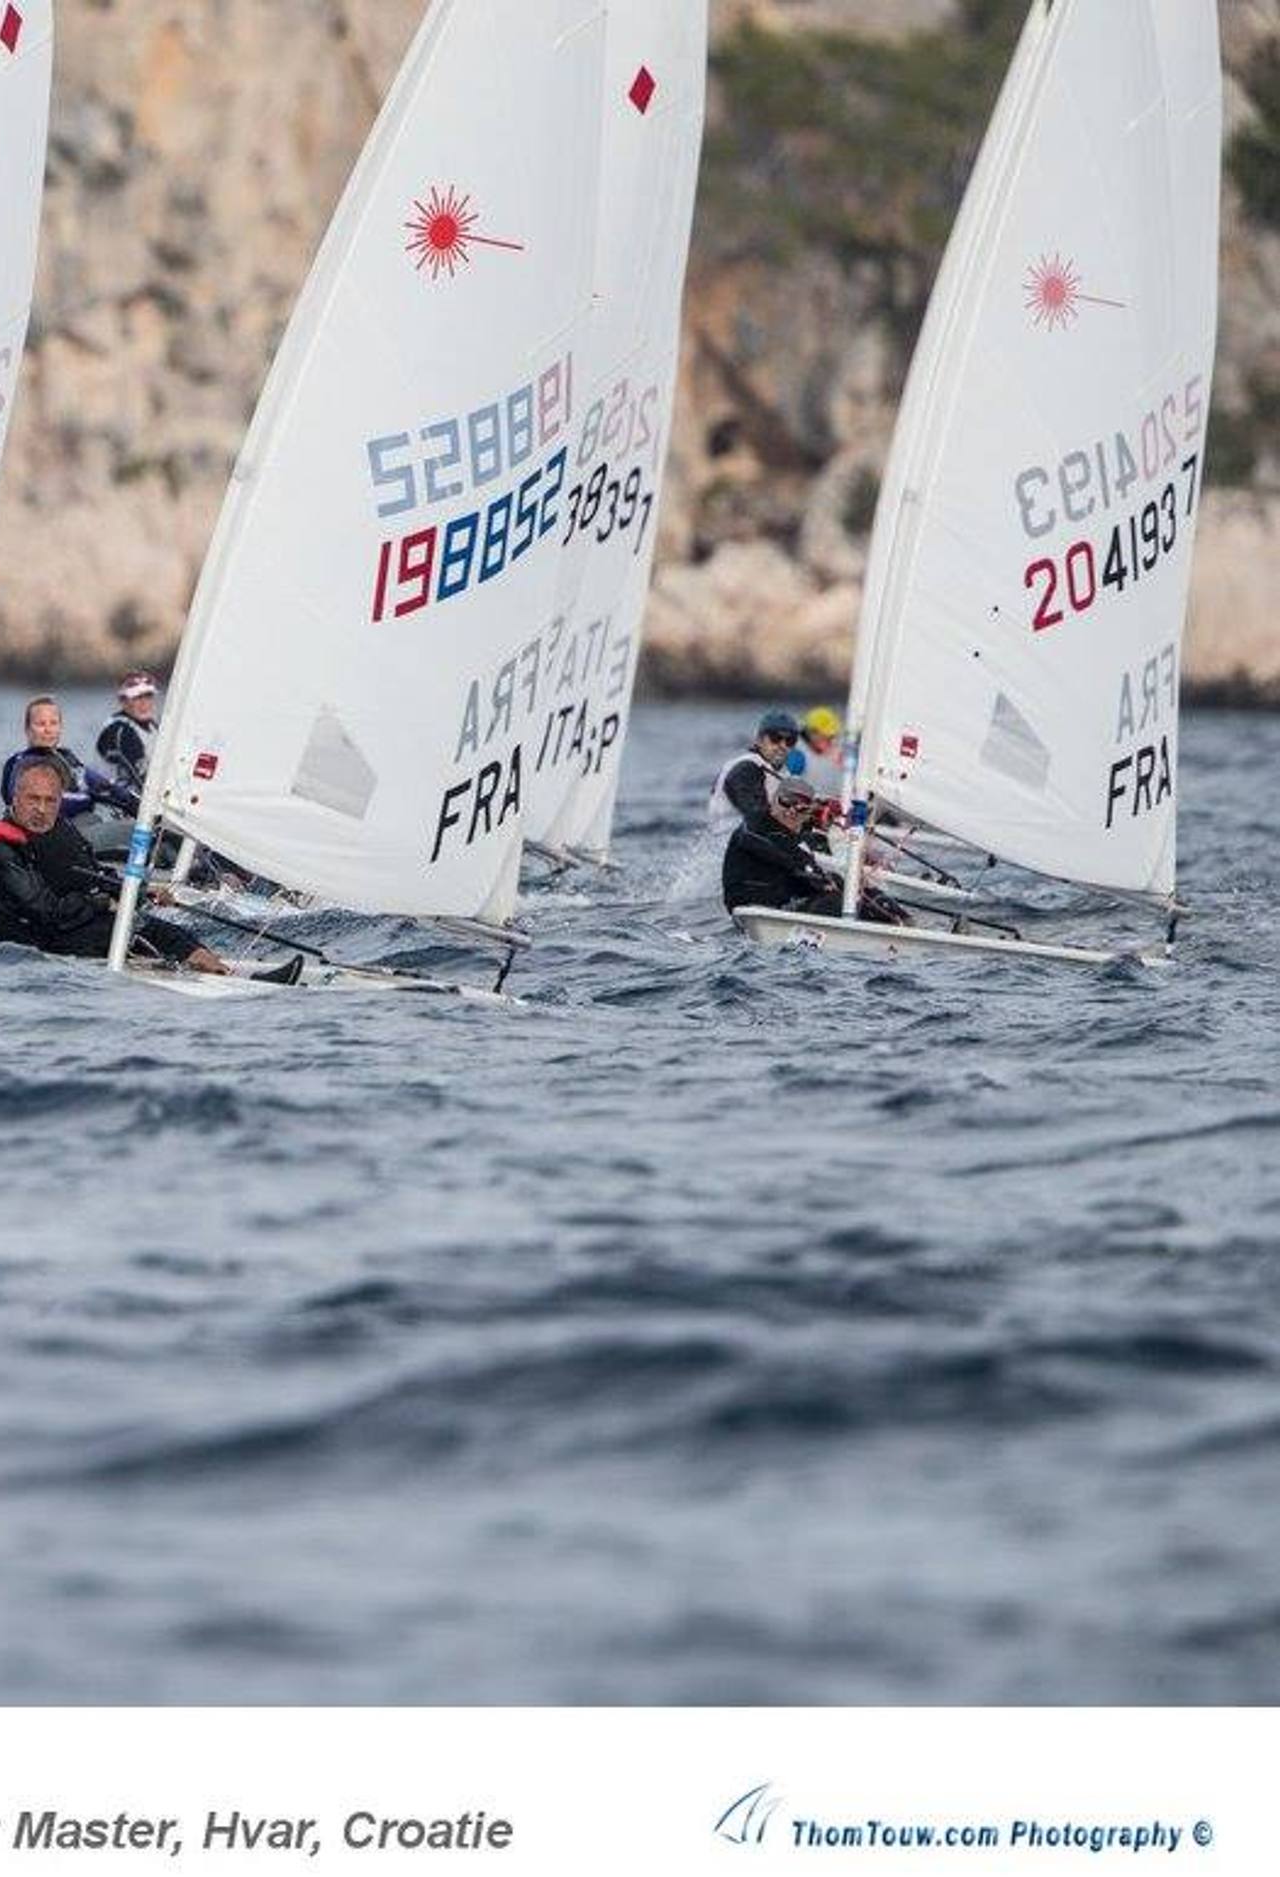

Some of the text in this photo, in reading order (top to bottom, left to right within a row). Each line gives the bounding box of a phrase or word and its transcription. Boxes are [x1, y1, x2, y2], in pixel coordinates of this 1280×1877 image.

[371, 445, 569, 621] 198852
[1024, 482, 1177, 631] 204193
[431, 744, 521, 863] FRA
[1105, 735, 1171, 829] FRA
